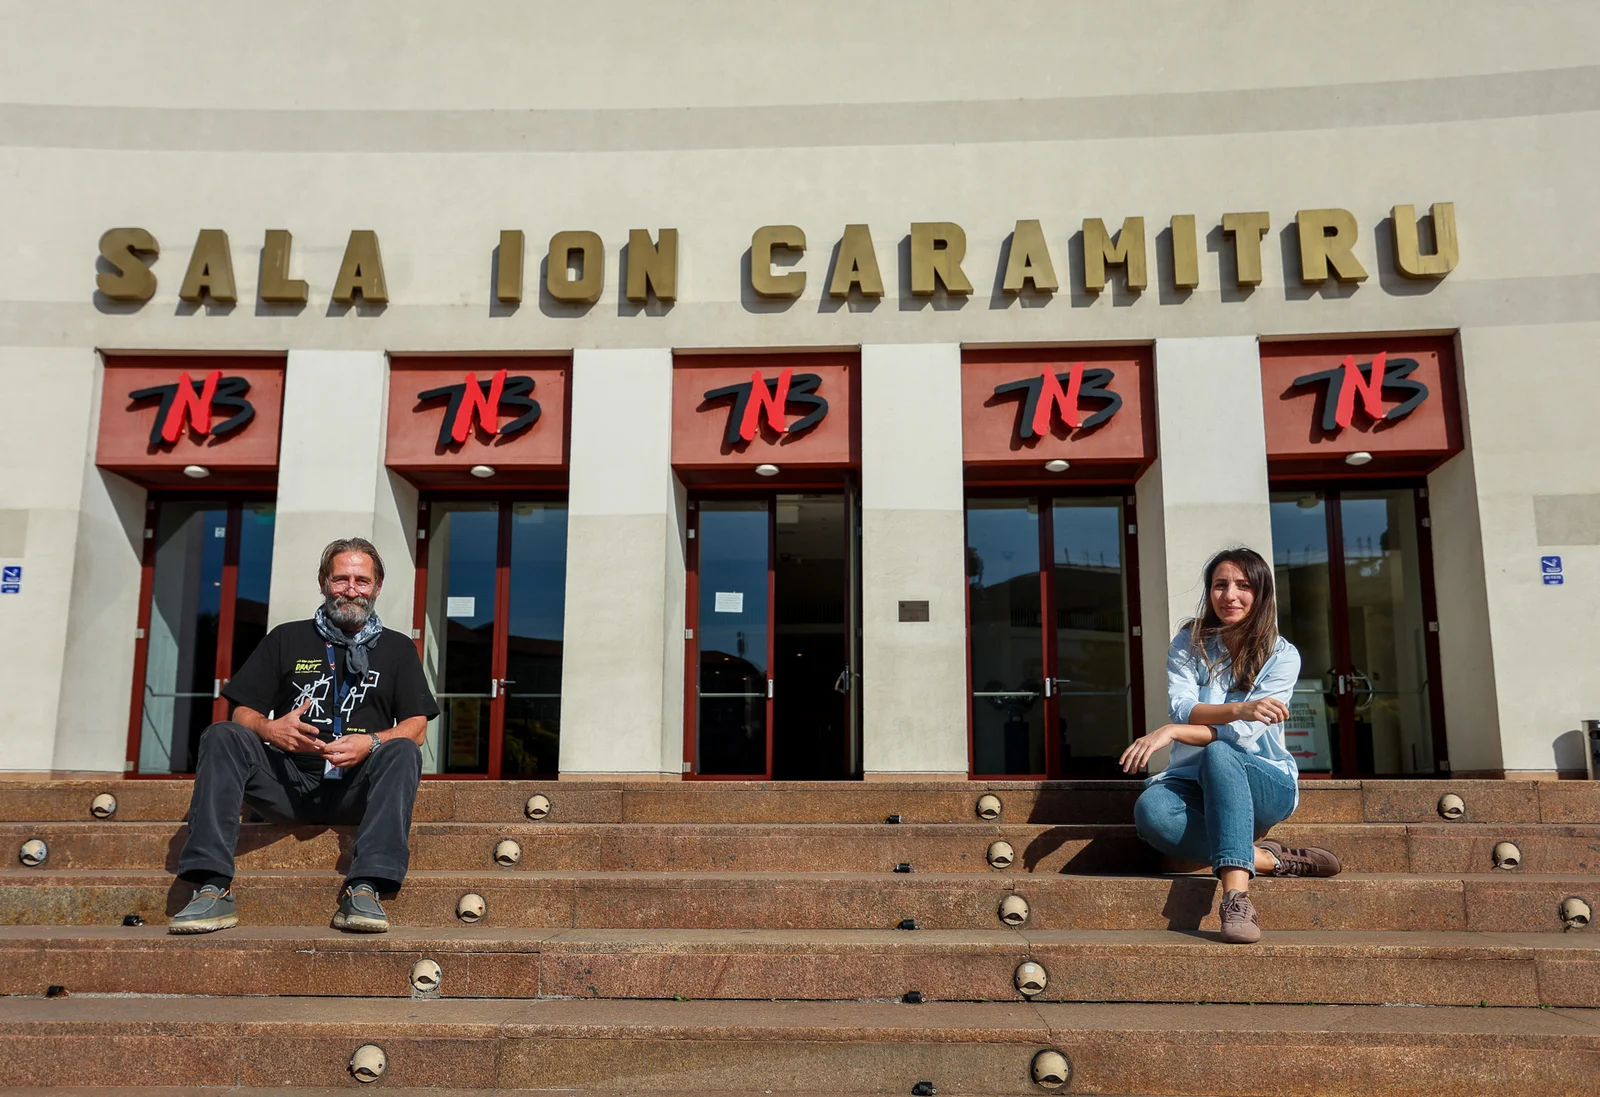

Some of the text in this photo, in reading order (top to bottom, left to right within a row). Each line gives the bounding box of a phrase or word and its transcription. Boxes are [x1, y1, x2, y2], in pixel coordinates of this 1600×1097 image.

[96, 202, 1460, 302] SALA ION CARAMITRU
[129, 370, 256, 445] TNB
[417, 369, 541, 445] TNB
[703, 367, 829, 444] TNB
[995, 361, 1123, 439] TNB
[1293, 351, 1429, 431] TNB
